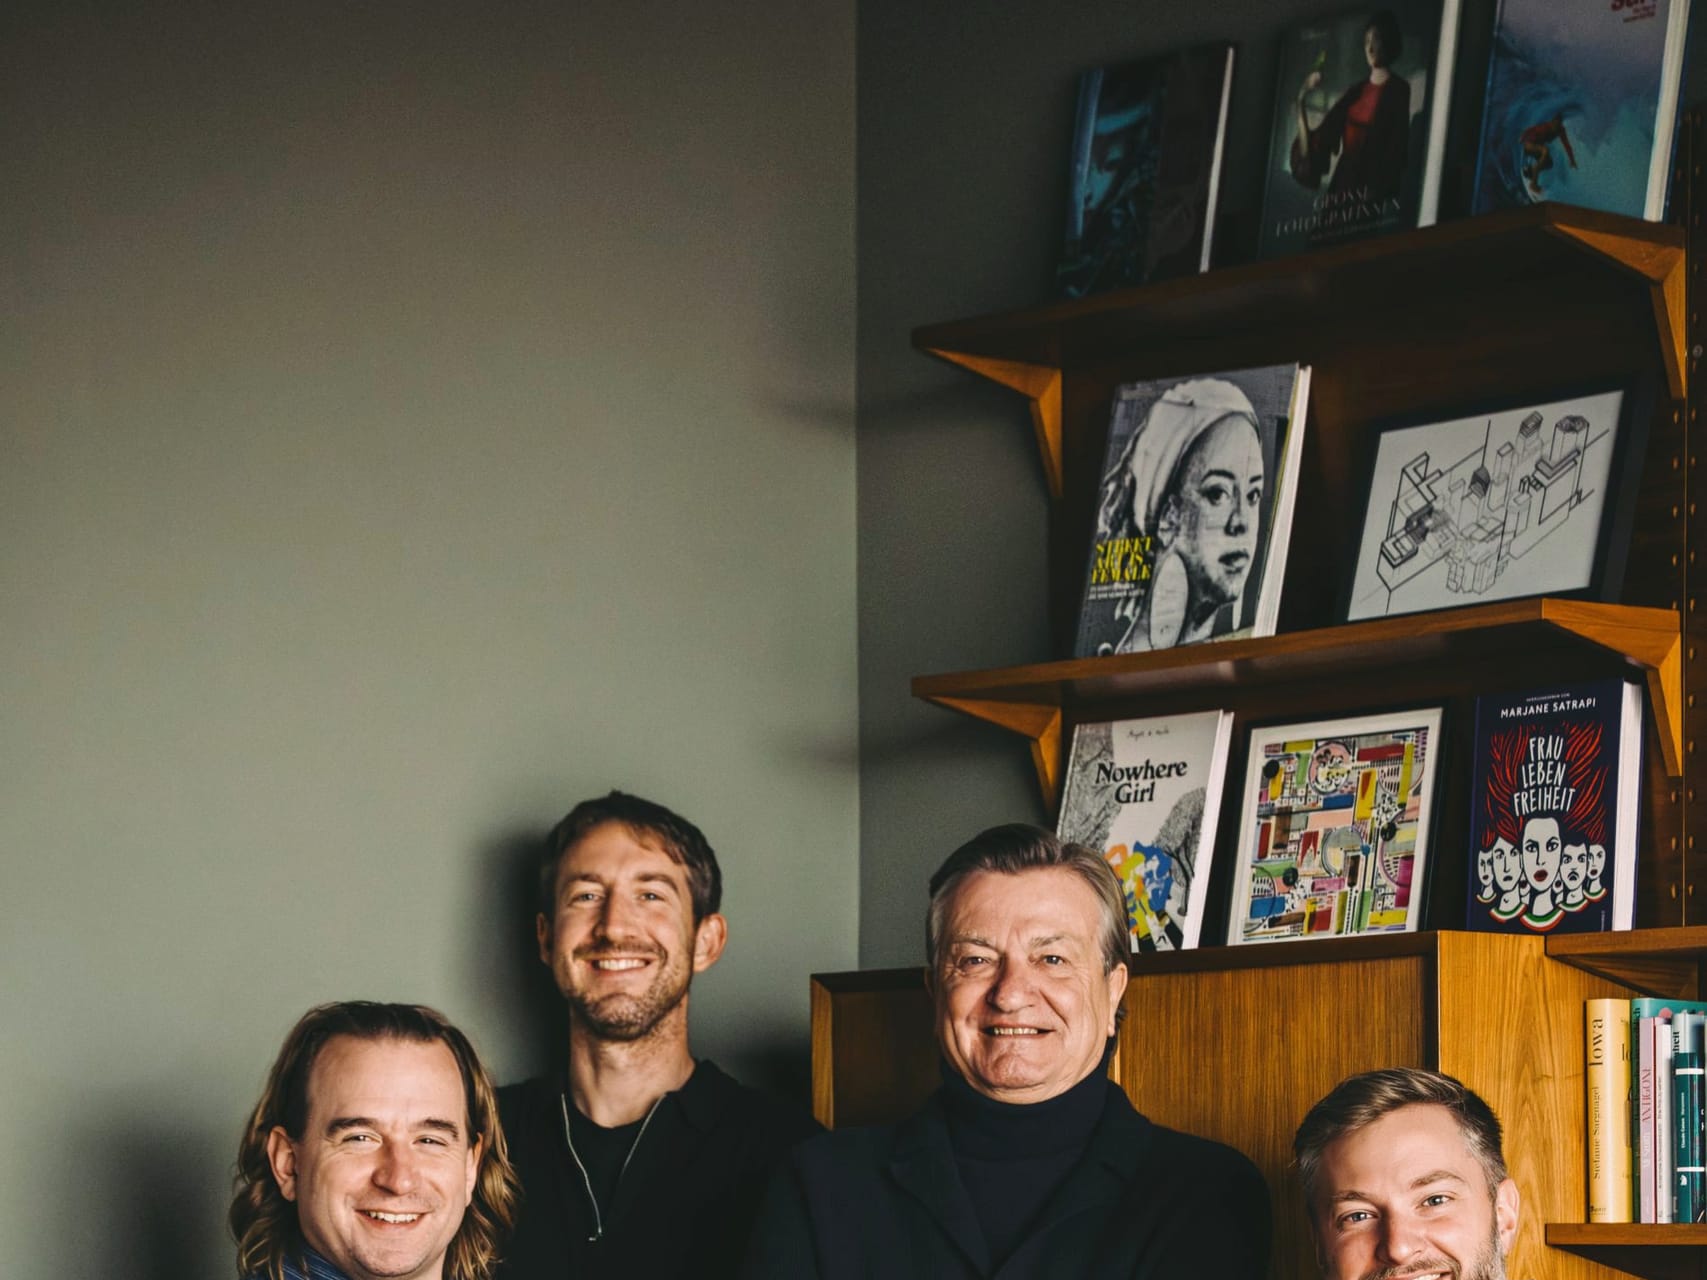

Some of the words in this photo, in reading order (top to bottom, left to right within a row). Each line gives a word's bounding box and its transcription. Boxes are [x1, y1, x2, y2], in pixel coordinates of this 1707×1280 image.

[1095, 536, 1152, 554] STREET
[1500, 702, 1549, 719] MARJANE
[1552, 697, 1596, 713] SATRAPI
[1529, 734, 1564, 762] FRAU
[1095, 757, 1188, 785] Nowhere
[1522, 760, 1567, 789] LEBEN
[1114, 781, 1156, 804] Girl
[1513, 785, 1577, 817] FREIHEIT
[1588, 1017, 1604, 1067] Iowa
[1592, 1086, 1602, 1136] Sargnagel
[1592, 1138, 1601, 1180] Stefanie
